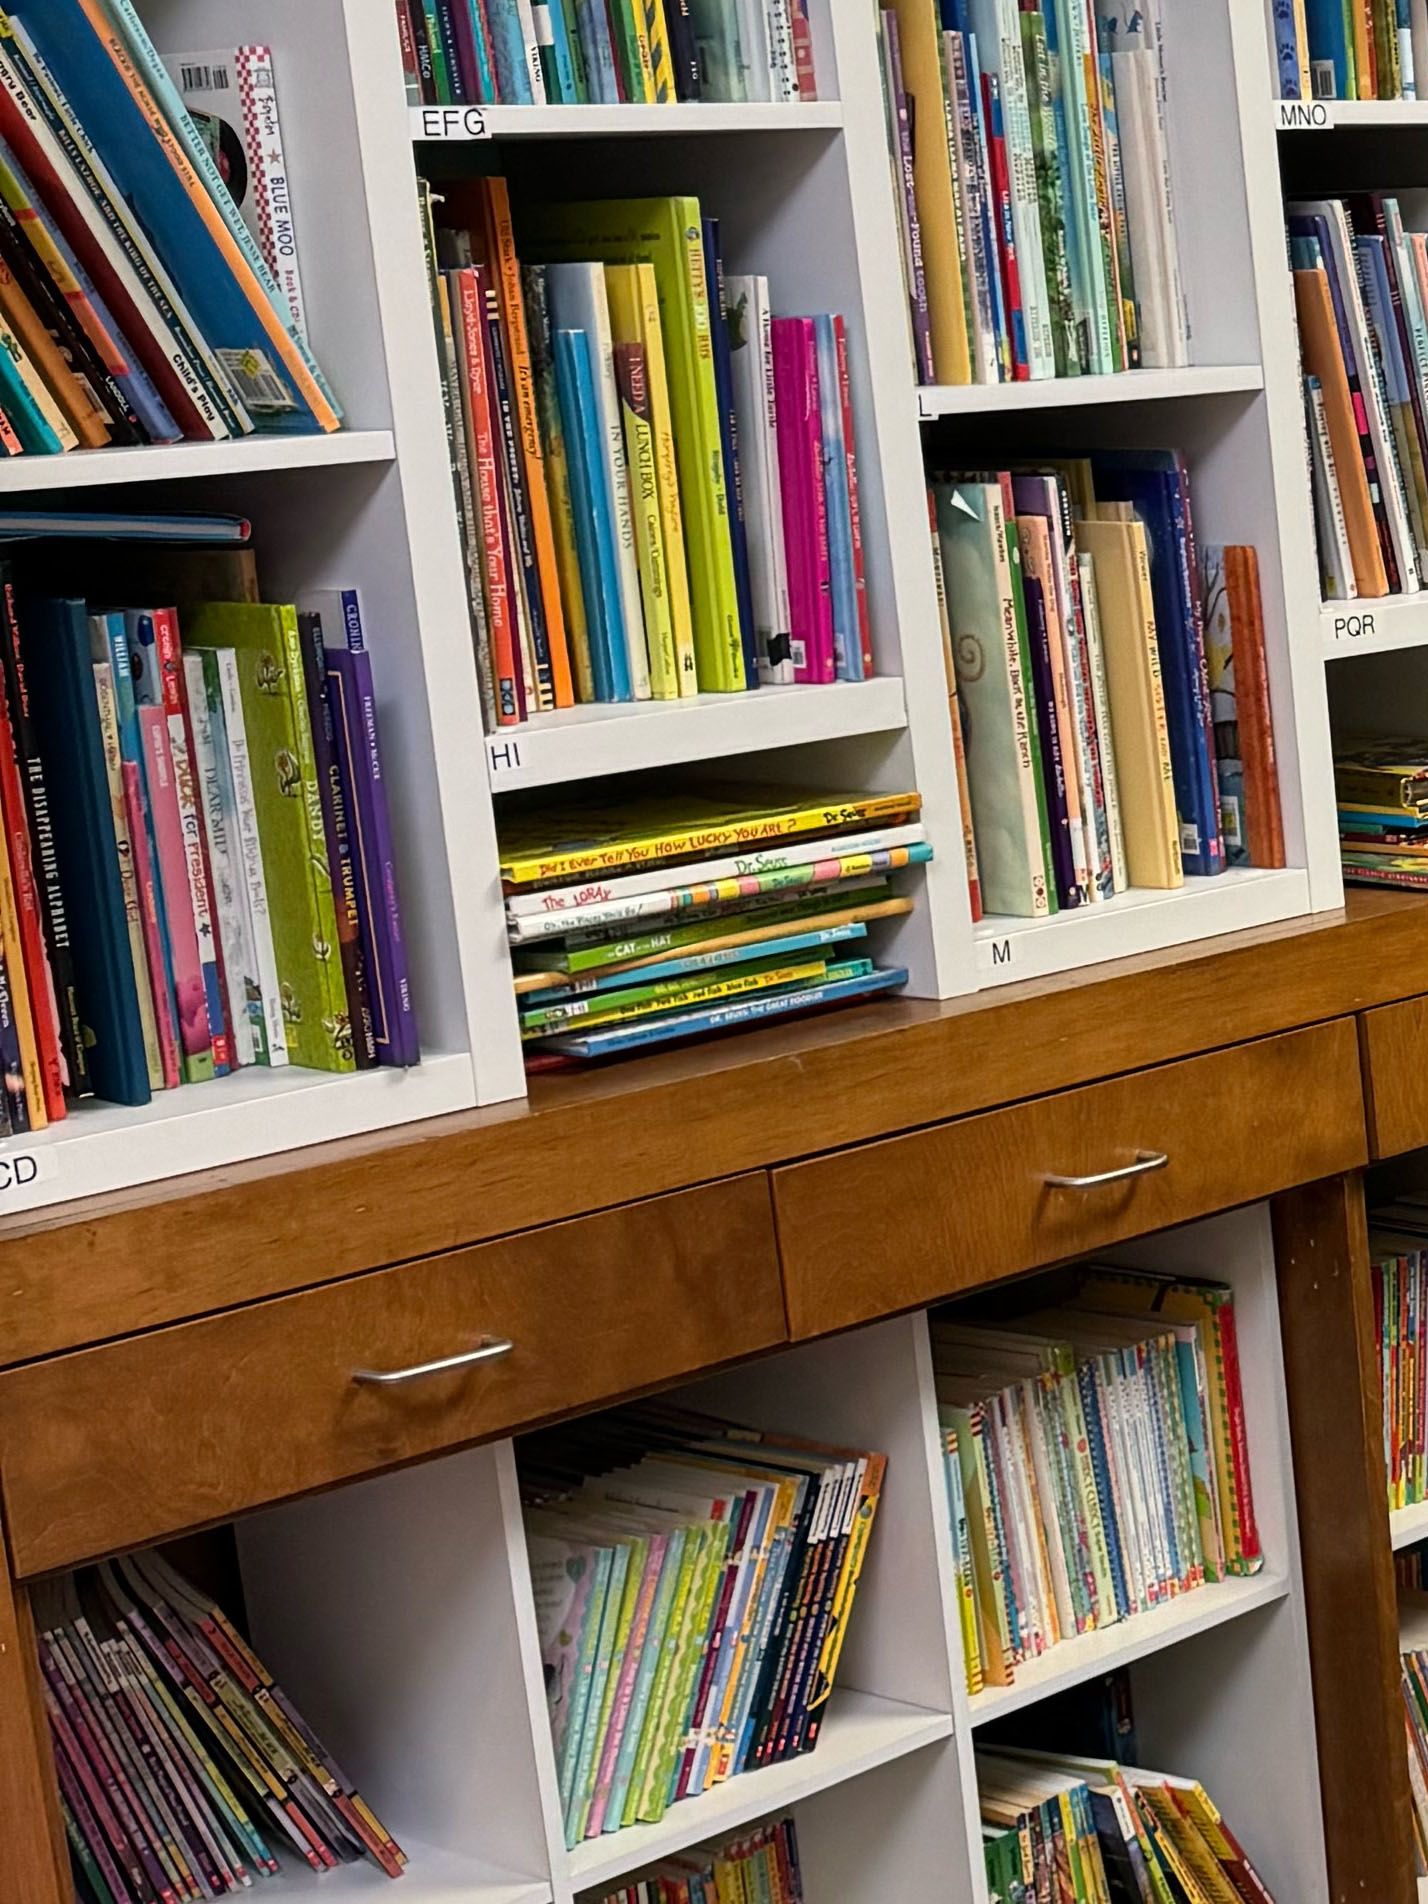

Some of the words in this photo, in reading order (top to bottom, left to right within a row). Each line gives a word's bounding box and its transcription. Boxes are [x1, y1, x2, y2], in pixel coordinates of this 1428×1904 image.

[423, 108, 486, 137] EFG
[1280, 104, 1327, 126] MNO
[270, 177, 286, 213] BLUE
[277, 216, 295, 256] MOO
[171, 353, 199, 392] Child's
[192, 391, 217, 422] Play
[346, 603, 359, 653] CRONIN
[1334, 616, 1375, 639] PQR
[490, 745, 520, 769] HI
[306, 780, 325, 841] DANDY
[34, 794, 62, 882] DISAPPEARING
[327, 765, 345, 843] CLARINET
[339, 858, 359, 927] TRUMPET
[568, 855, 597, 871] Ever
[598, 851, 623, 865] Tell
[625, 847, 649, 862] You
[654, 839, 686, 855] HOW
[689, 831, 731, 850] LUCKY
[733, 827, 759, 843] YOU
[542, 895, 566, 910] The
[614, 943, 635, 957] CAT
[651, 934, 672, 949] HAT
[992, 941, 1011, 963] M
